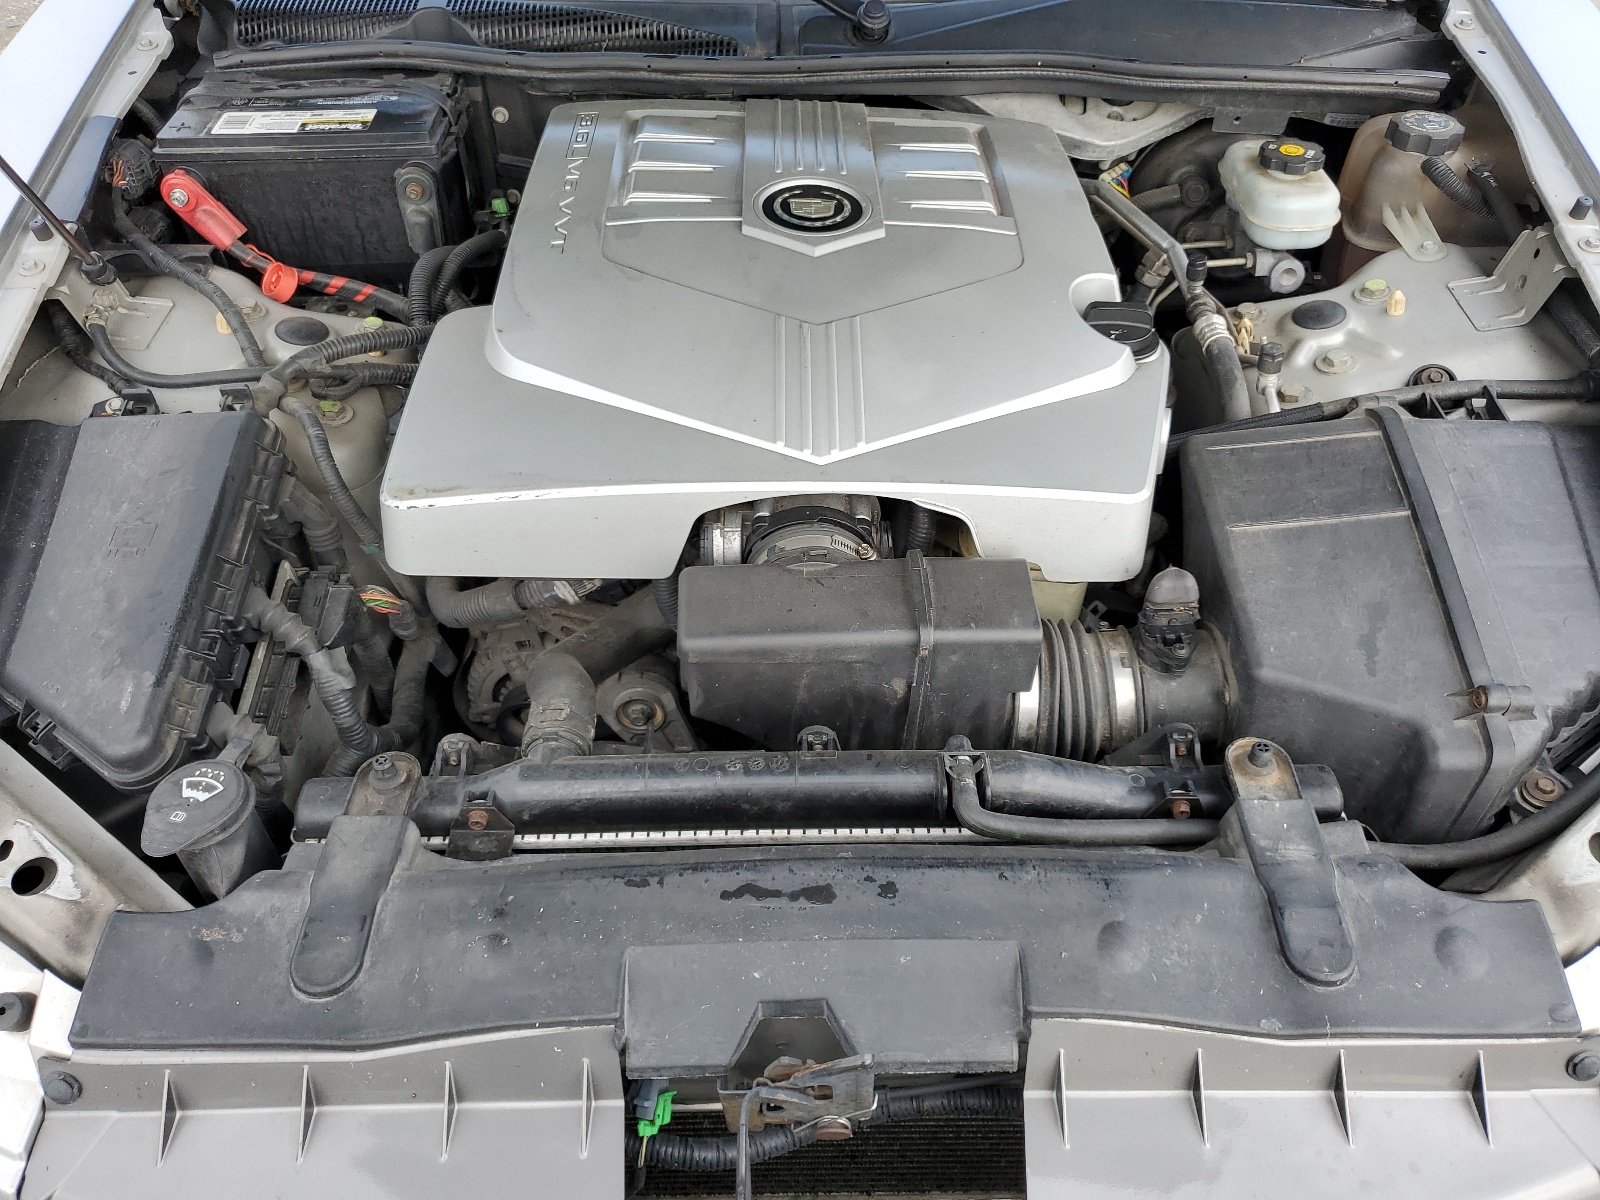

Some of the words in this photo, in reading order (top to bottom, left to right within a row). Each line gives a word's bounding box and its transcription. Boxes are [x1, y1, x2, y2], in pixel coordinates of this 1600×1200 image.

[306, 122, 364, 131] Duralast
[570, 113, 595, 157] 3.6L
[563, 159, 584, 192] V6
[550, 196, 576, 255] VVT
